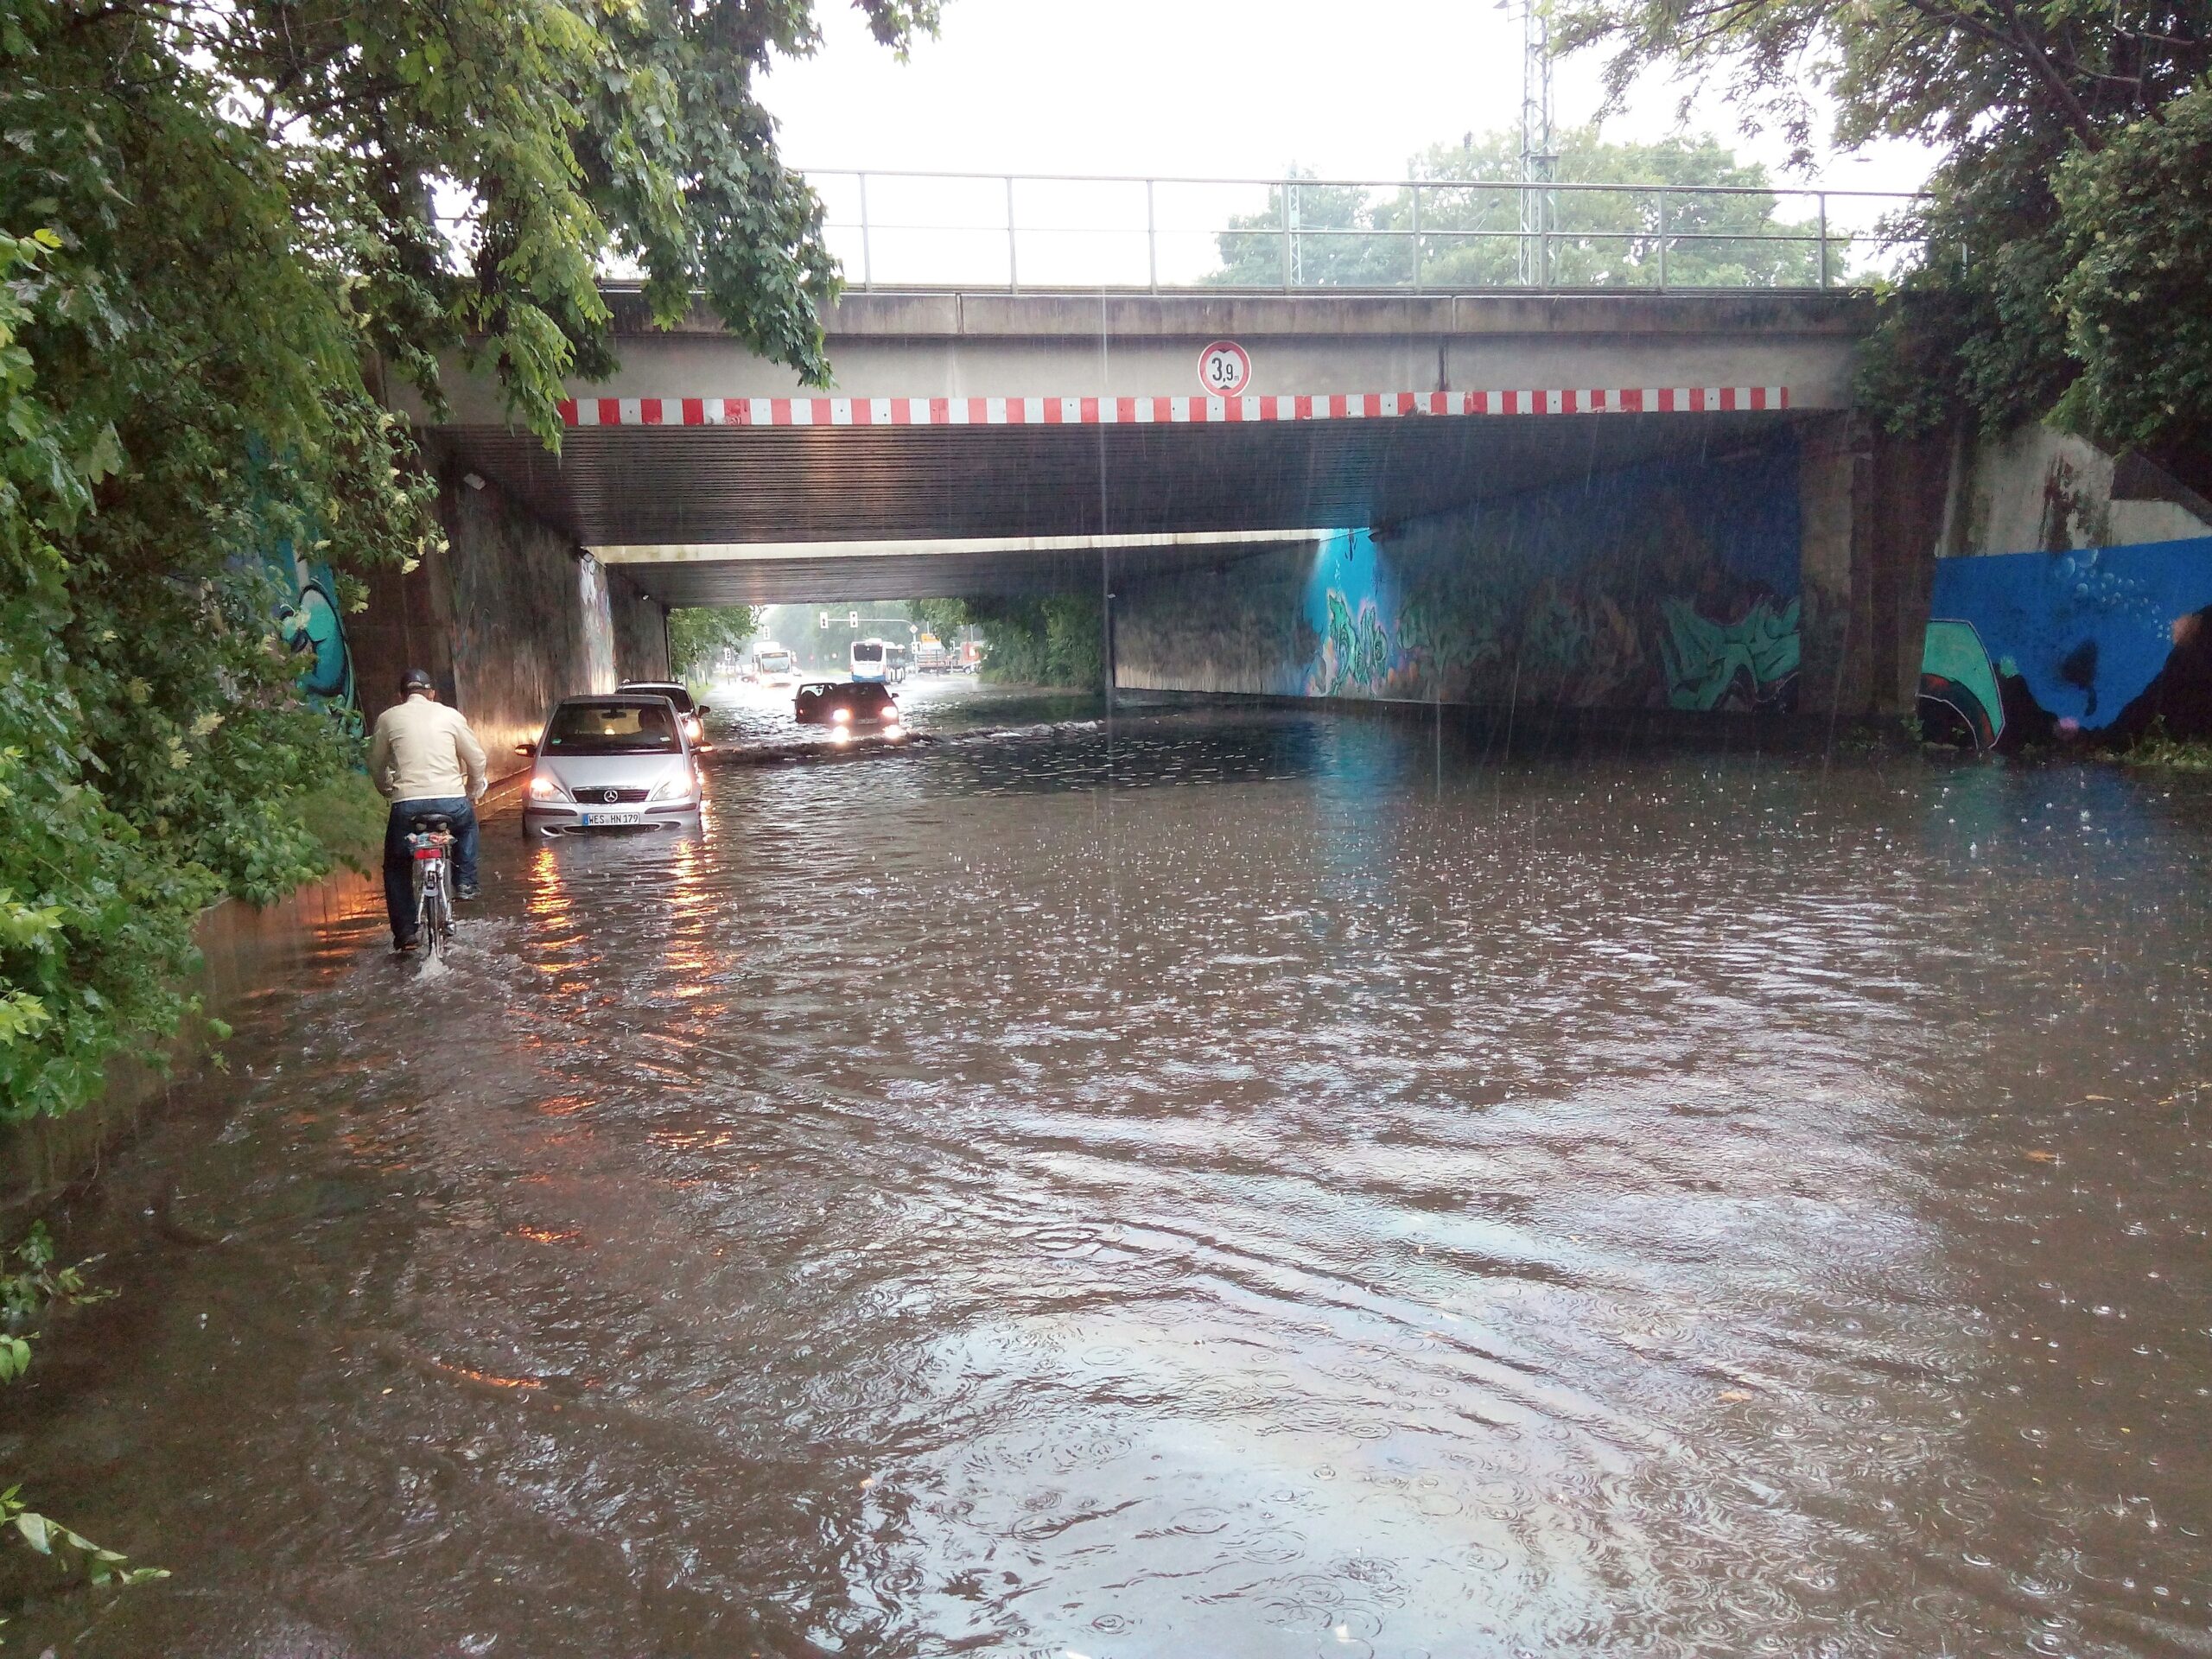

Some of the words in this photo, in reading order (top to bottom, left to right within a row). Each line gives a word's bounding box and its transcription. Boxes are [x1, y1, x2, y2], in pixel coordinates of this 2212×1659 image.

[1211, 357, 1234, 383] 3,9
[588, 815, 605, 824] WES
[610, 814, 621, 823] HN
[623, 814, 639, 823] 179
